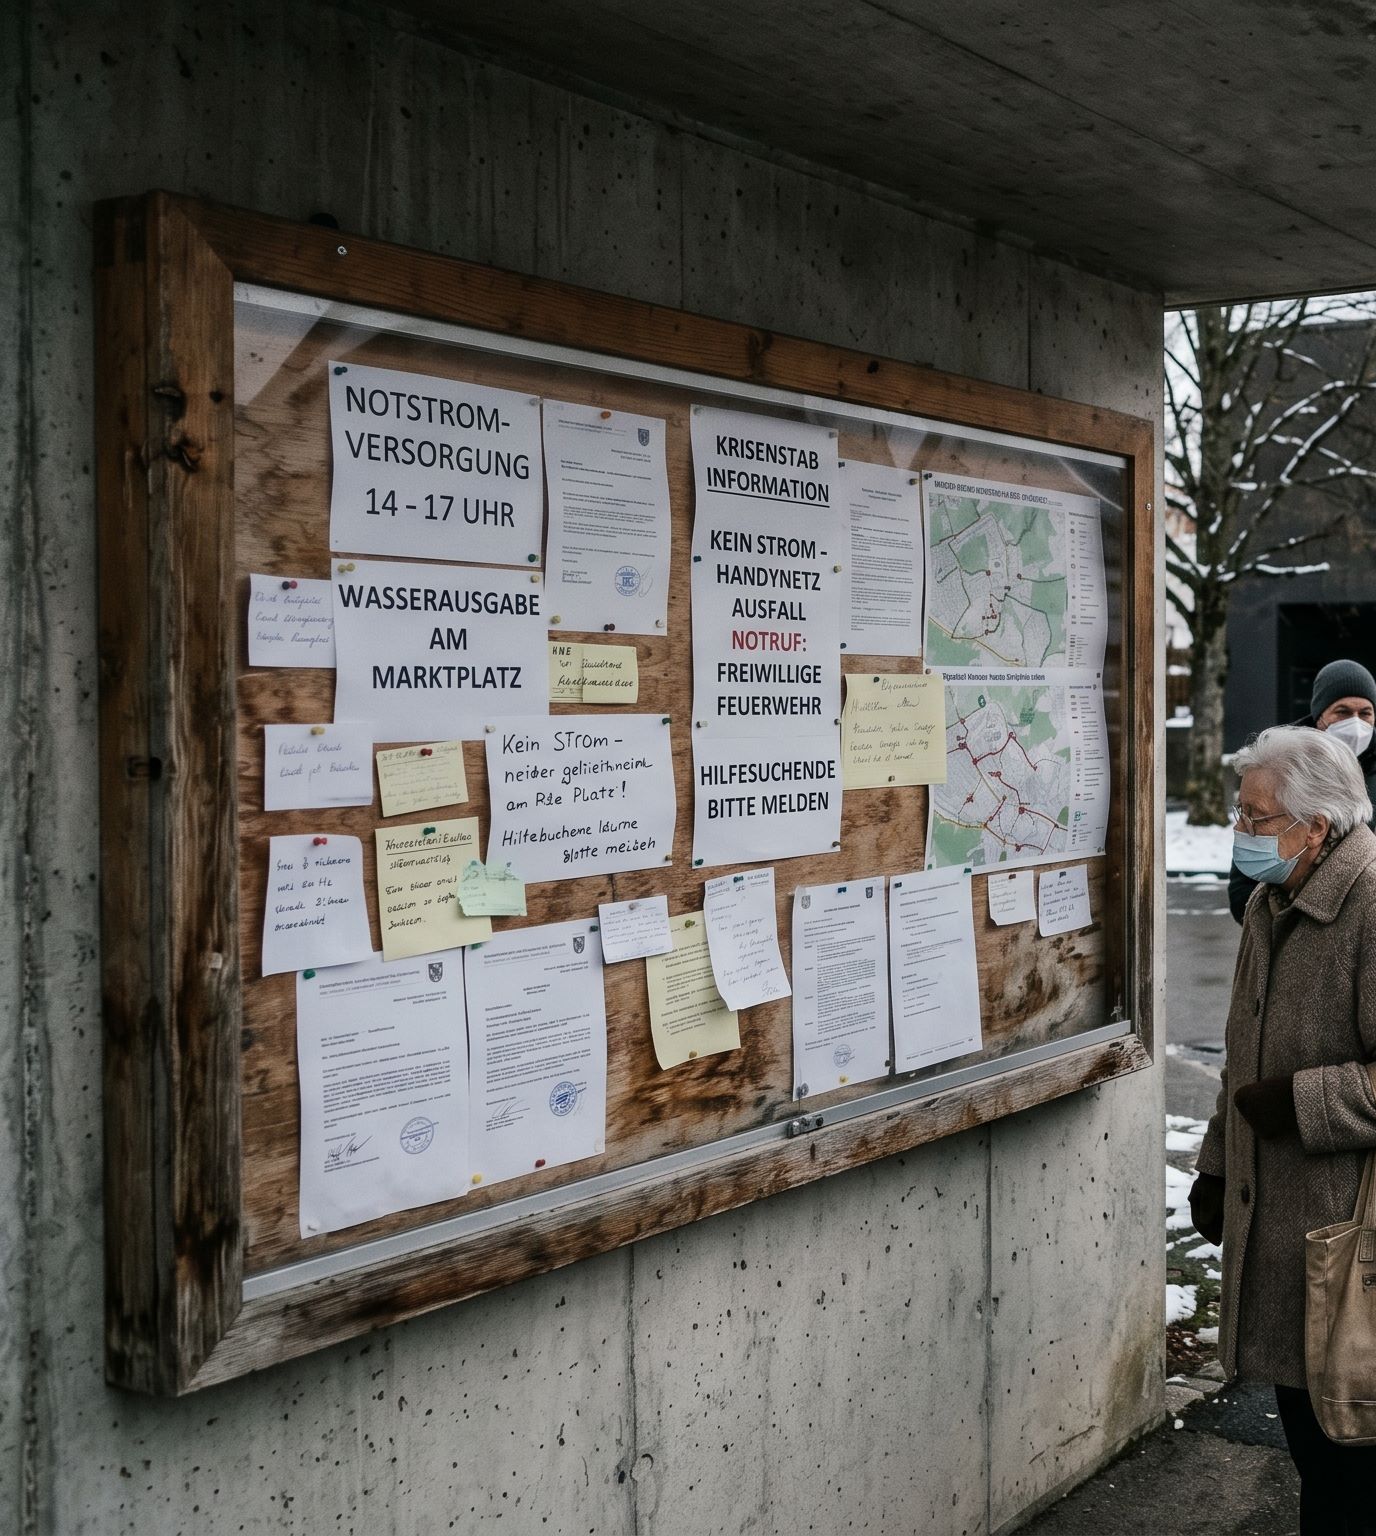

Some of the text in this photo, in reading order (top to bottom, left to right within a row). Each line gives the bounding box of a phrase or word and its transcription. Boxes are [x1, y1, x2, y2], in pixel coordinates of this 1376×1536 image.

[345, 385, 511, 434] NOTSTROM-
[345, 430, 530, 480] VERSORGUNG
[715, 434, 819, 471] KRISENSTAB
[707, 466, 829, 503] INFORMATION
[366, 487, 398, 517] 14
[424, 493, 455, 521] 17
[463, 497, 515, 528] UHR
[710, 529, 752, 554] KEIN
[756, 534, 816, 560] STROM
[716, 563, 821, 592] HANDYNETZ
[338, 583, 540, 616] WASSERAUSGABE
[731, 597, 807, 622] AUSFALL
[429, 627, 468, 651] AM
[732, 630, 807, 652] NOTRUF:
[372, 665, 522, 689] MARKTPLATZ
[717, 662, 822, 684] FREIWILLIGE
[717, 695, 822, 716] FEUERWEHR
[502, 734, 541, 755] Kein
[700, 759, 836, 786] HILFESUCHENDE
[506, 800, 528, 811] am
[707, 791, 829, 820] BITTE MELDEN
